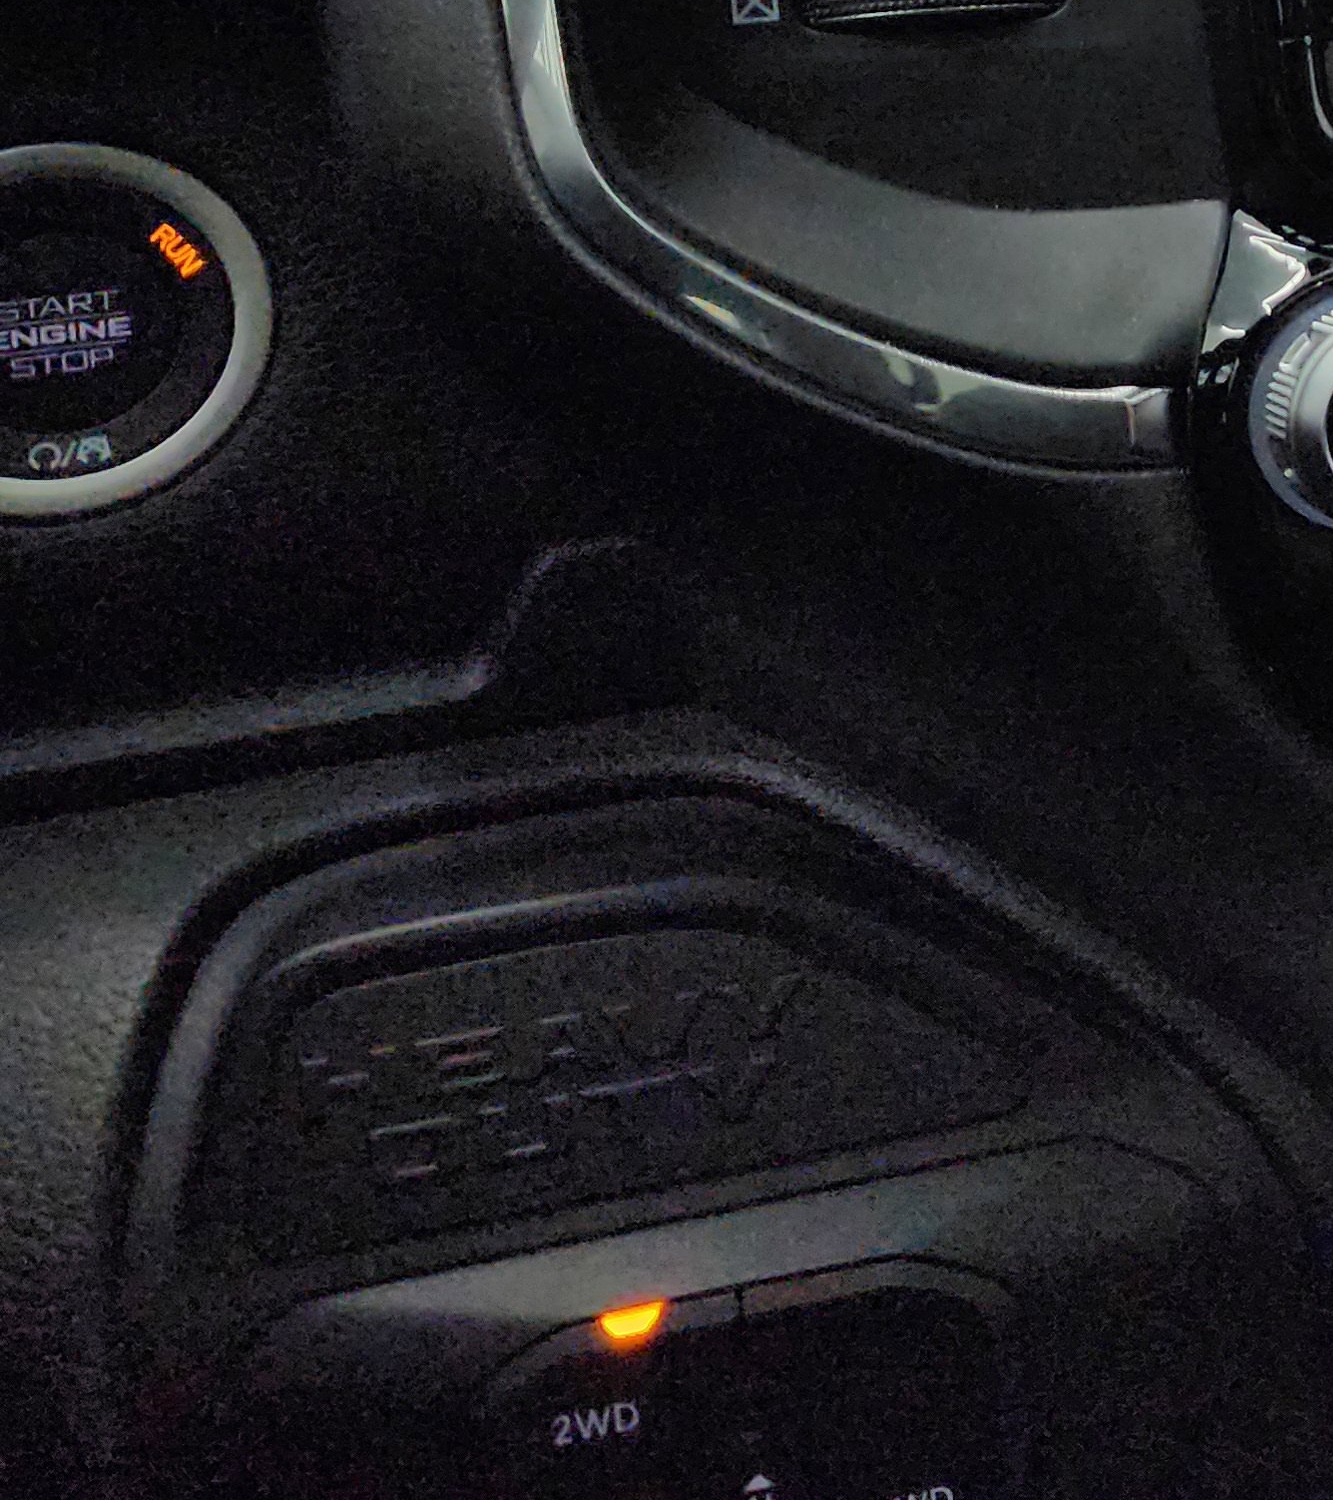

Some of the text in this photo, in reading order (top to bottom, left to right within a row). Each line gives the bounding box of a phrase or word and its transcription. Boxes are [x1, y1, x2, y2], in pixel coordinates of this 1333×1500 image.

[150, 222, 208, 279] RUN
[0, 289, 120, 321] START
[11, 347, 114, 379] STOP
[553, 1401, 641, 1447] 2WD
